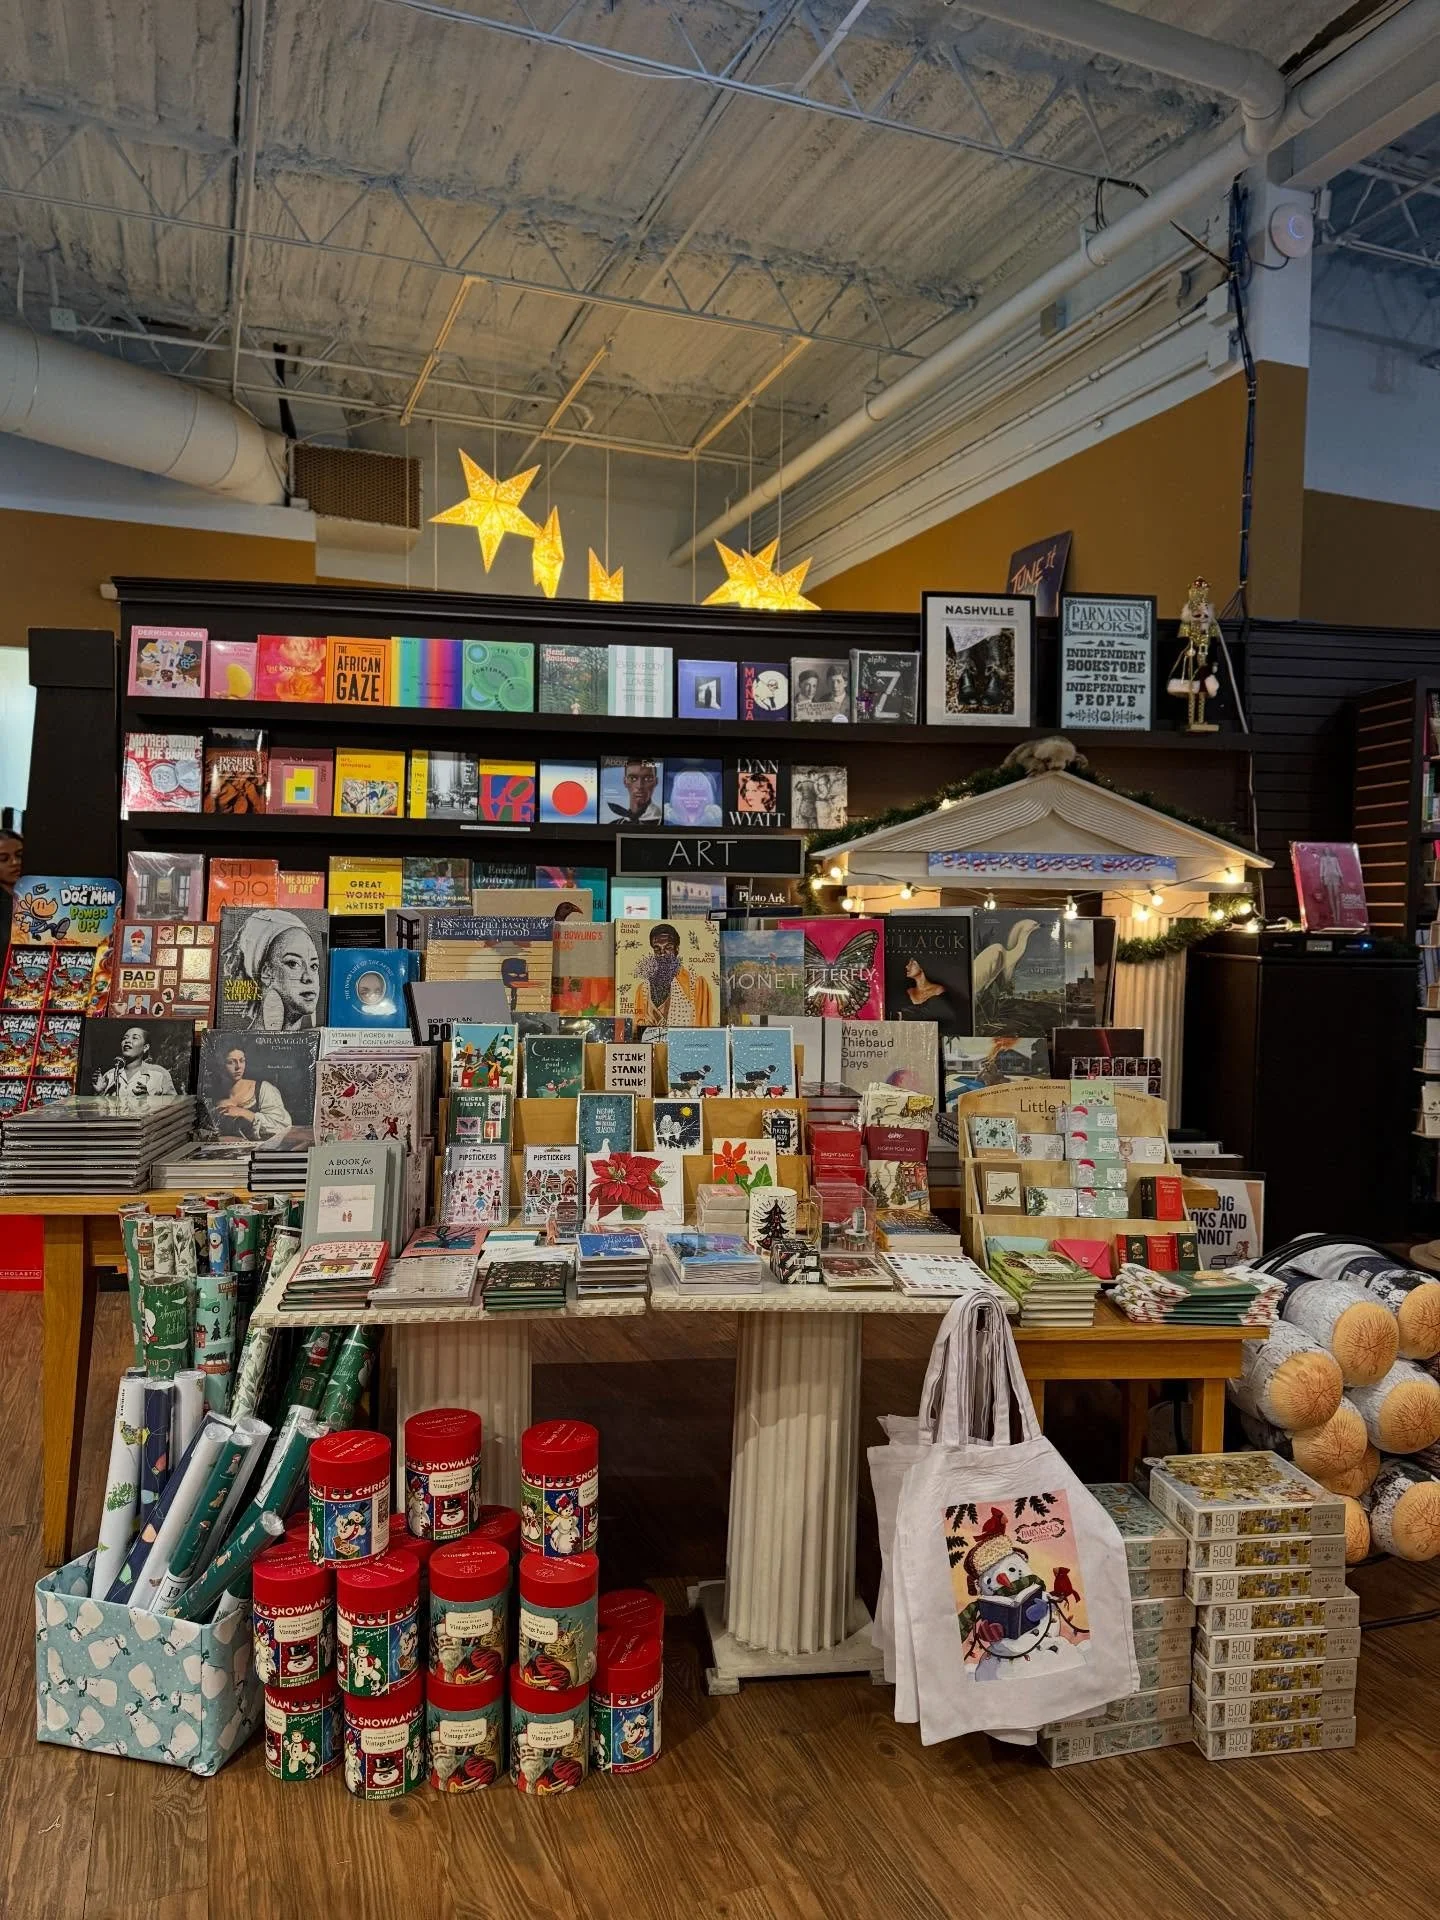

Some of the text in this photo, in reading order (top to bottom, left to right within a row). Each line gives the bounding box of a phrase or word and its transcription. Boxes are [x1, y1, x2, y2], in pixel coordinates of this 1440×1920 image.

[945, 605, 1015, 617] NASHVILLE
[1071, 605, 1143, 623] PARNASSUS
[1079, 621, 1134, 633] BOOKS
[173, 630, 203, 638] ADAMS
[1097, 639, 1115, 649] AN
[1066, 648, 1146, 661] INDEPENDENT
[337, 657, 380, 673] AFRICAN
[1066, 661, 1146, 674] BOOKSTORE
[1094, 674, 1118, 682] FOR
[336, 673, 379, 702] GAZE
[1066, 684, 1146, 695] INDEPENDENT
[744, 667, 755, 721] MANGA
[1075, 695, 1136, 708] PEOPLE
[219, 755, 255, 765] DESERT
[737, 759, 779, 773] LYNN
[219, 764, 254, 772] IMAGES
[729, 811, 786, 827] WYATT
[668, 839, 738, 867] ART
[943, 853, 1156, 872] SANTA'S BOOK SHOP
[219, 862, 252, 879] STU
[487, 865, 527, 875] Emerald
[297, 875, 320, 885] STORY
[349, 880, 382, 889] GREAT
[477, 875, 515, 884] Drifters
[233, 880, 268, 897] DIO
[288, 885, 314, 894] OF ART
[61, 889, 116, 906] DOG MAN
[345, 891, 385, 899] WOMEN
[739, 891, 786, 903] Photo Ark
[345, 902, 385, 910] ARTISTS
[78, 919, 100, 933] UP!
[16, 954, 50, 967] DOG MAN
[60, 954, 92, 967] DOG MAN
[123, 970, 156, 981] BAD
[721, 973, 798, 989] MONET
[122, 981, 155, 989] DADS
[3, 1019, 36, 1031] DOG MAN
[48, 1019, 81, 1031] DOG MAN
[842, 1026, 878, 1041] Wayne
[842, 1037, 894, 1048] Thiebaud
[611, 1053, 646, 1062] STINK!
[841, 1049, 888, 1059] Summer
[611, 1065, 646, 1074] STANK!
[842, 1059, 869, 1070] Days
[611, 1078, 646, 1087] STUNK!
[36, 1085, 68, 1097] DOG MAN
[1020, 1098, 1055, 1114] Little
[458, 1153, 497, 1162] PIPSTICKERS
[533, 1154, 571, 1162] PIPSTICKERS
[748, 1149, 771, 1157] thinking
[328, 1157, 372, 1166] A BOOK for
[324, 1167, 374, 1176] CHRISTMAS
[1219, 1213, 1247, 1230] AND
[425, 1456, 476, 1473] SNOWMAN
[433, 1479, 471, 1491] Vintage Puzzle
[1214, 1513, 1235, 1528] 500
[1212, 1545, 1233, 1558] 500
[1214, 1577, 1235, 1591] 500
[271, 1597, 326, 1616] SNOWMAN
[1228, 1607, 1248, 1621] 500
[279, 1621, 320, 1637] Vintage Puzzle
[449, 1621, 490, 1633] Vintage Puzzle
[1231, 1640, 1251, 1653] 500
[1228, 1672, 1247, 1685] 500
[1228, 1703, 1247, 1717] 500
[358, 1711, 412, 1728] SNOWMAN
[443, 1730, 483, 1740] Vintage Puzzle
[531, 1732, 571, 1742] Vintage Puzzle
[1228, 1732, 1248, 1746] 500
[365, 1735, 406, 1748] Vintage Puzzle
[1072, 1736, 1091, 1751] 500
